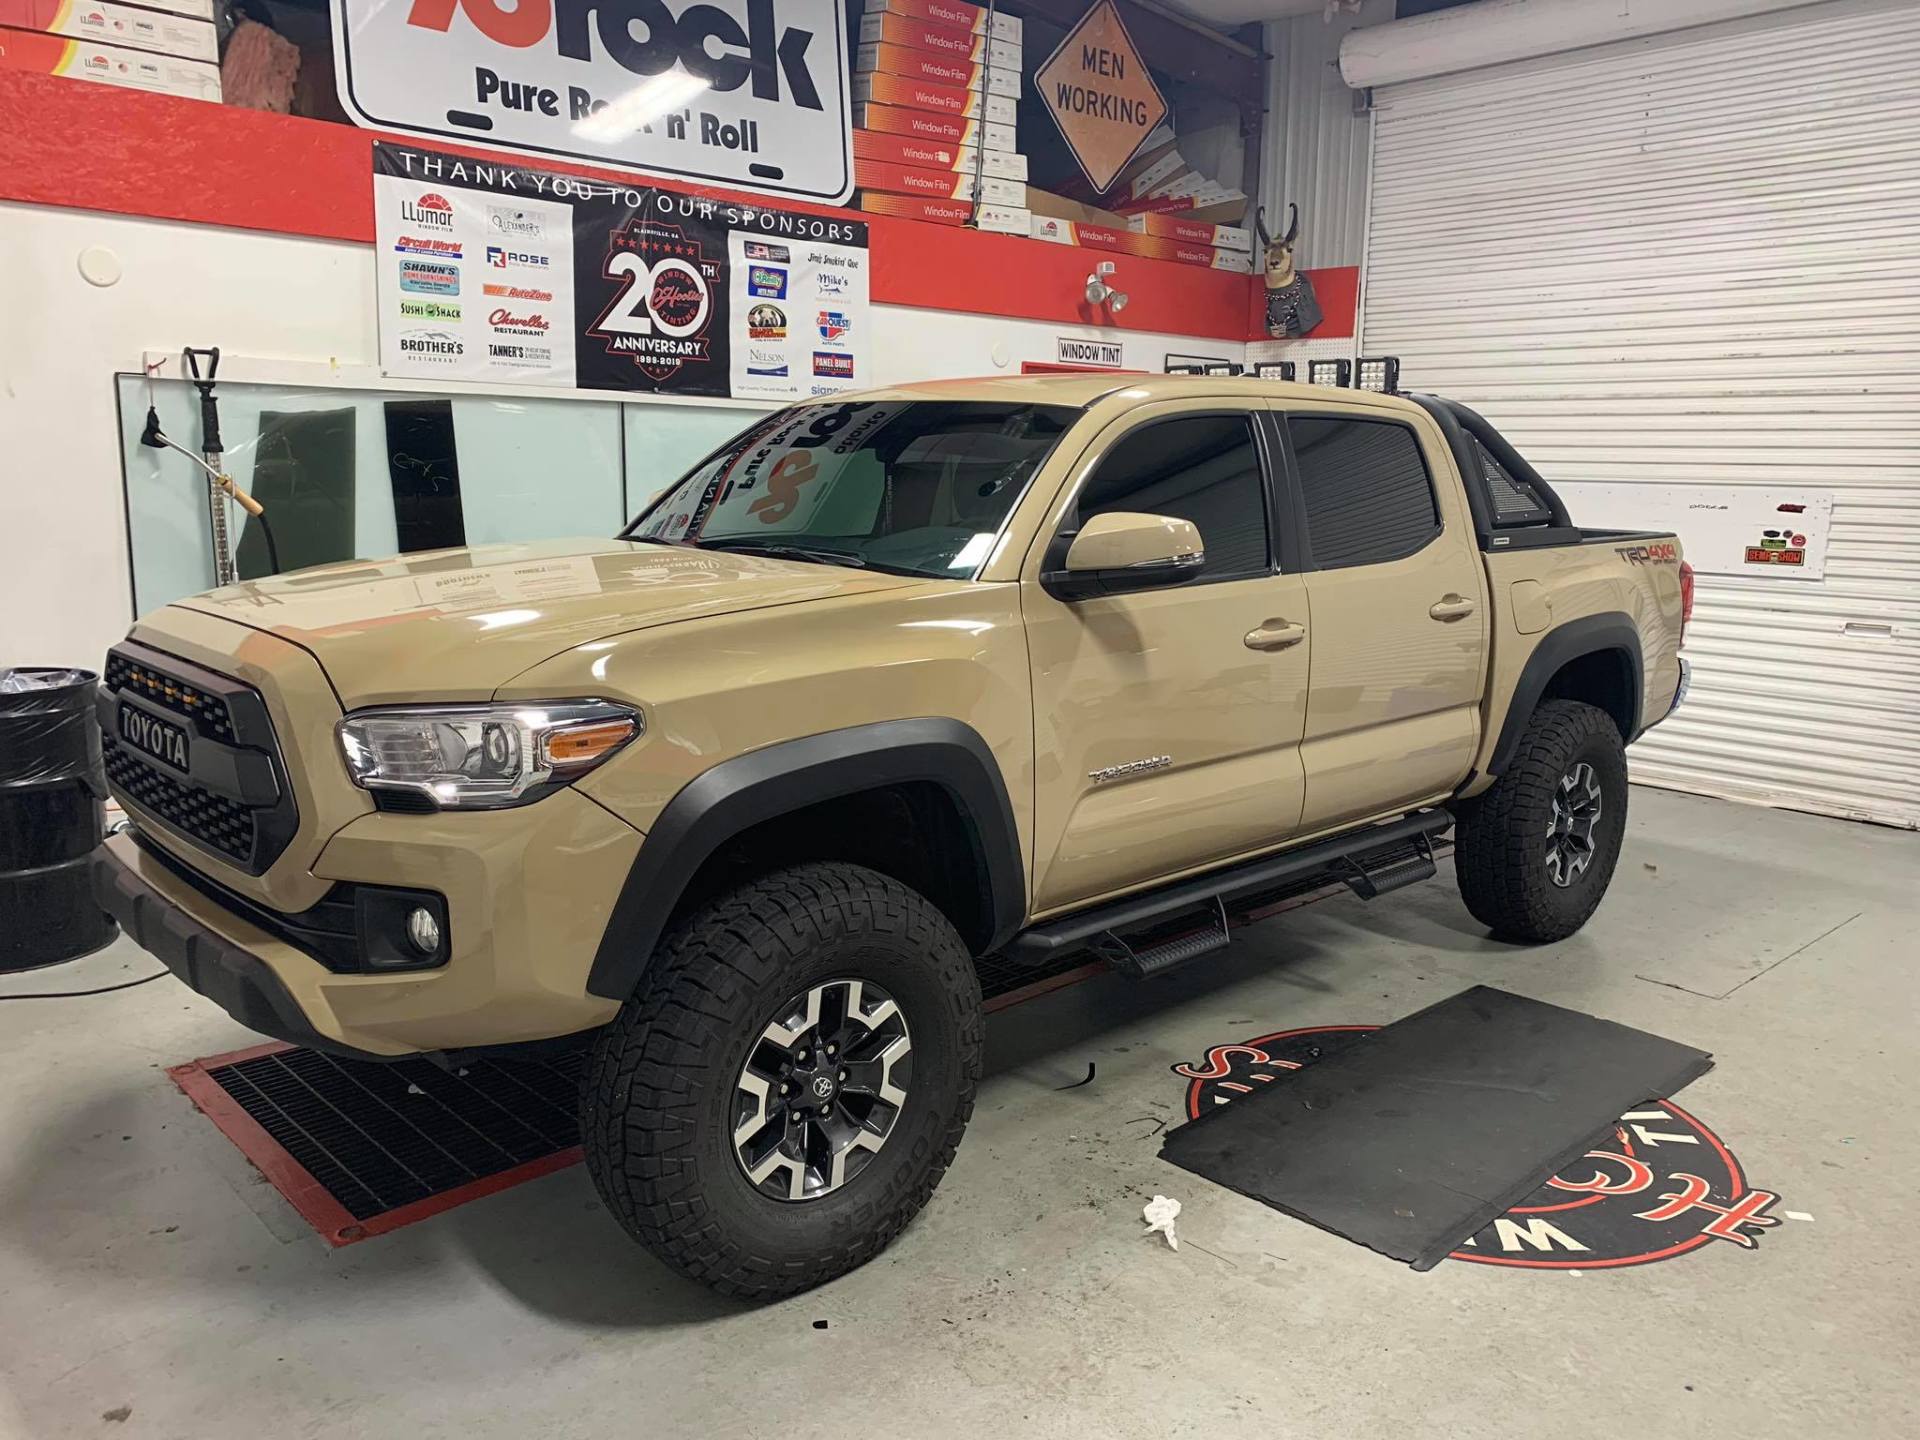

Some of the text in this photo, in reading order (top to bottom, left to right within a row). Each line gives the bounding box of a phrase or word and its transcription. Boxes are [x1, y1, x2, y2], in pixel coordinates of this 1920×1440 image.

[928, 5, 970, 25] Window Film
[925, 34, 969, 52] Window Film
[1082, 44, 1124, 80] MEN
[921, 63, 966, 81] Window Film
[915, 91, 961, 109] Window Film
[1056, 81, 1148, 127] WORKING
[475, 66, 560, 117] Pure
[700, 111, 759, 153] Roll
[912, 120, 959, 137] Window Film
[903, 148, 933, 161] Window
[904, 176, 950, 192] Window Film
[399, 151, 853, 241] THANK YOU TO OUR SPONSORS
[401, 199, 454, 226] LLumar
[924, 205, 970, 221] Window Film
[1079, 229, 1117, 244] Window Film
[1176, 226, 1211, 240] Window Film
[508, 252, 549, 266] ROSE
[1177, 250, 1198, 260] Window
[403, 262, 456, 276] SHAWN'S
[598, 251, 715, 338] 20 TH
[400, 302, 462, 319] SUSHI SHACK
[494, 326, 545, 337] RESTAURANT
[400, 338, 464, 355] BROTHER'S
[488, 344, 524, 359] TANNER'S
[613, 336, 702, 356] ANNIVERSARY
[1060, 342, 1120, 363] WINDOW TINT
[121, 706, 188, 768] TOYOTA
